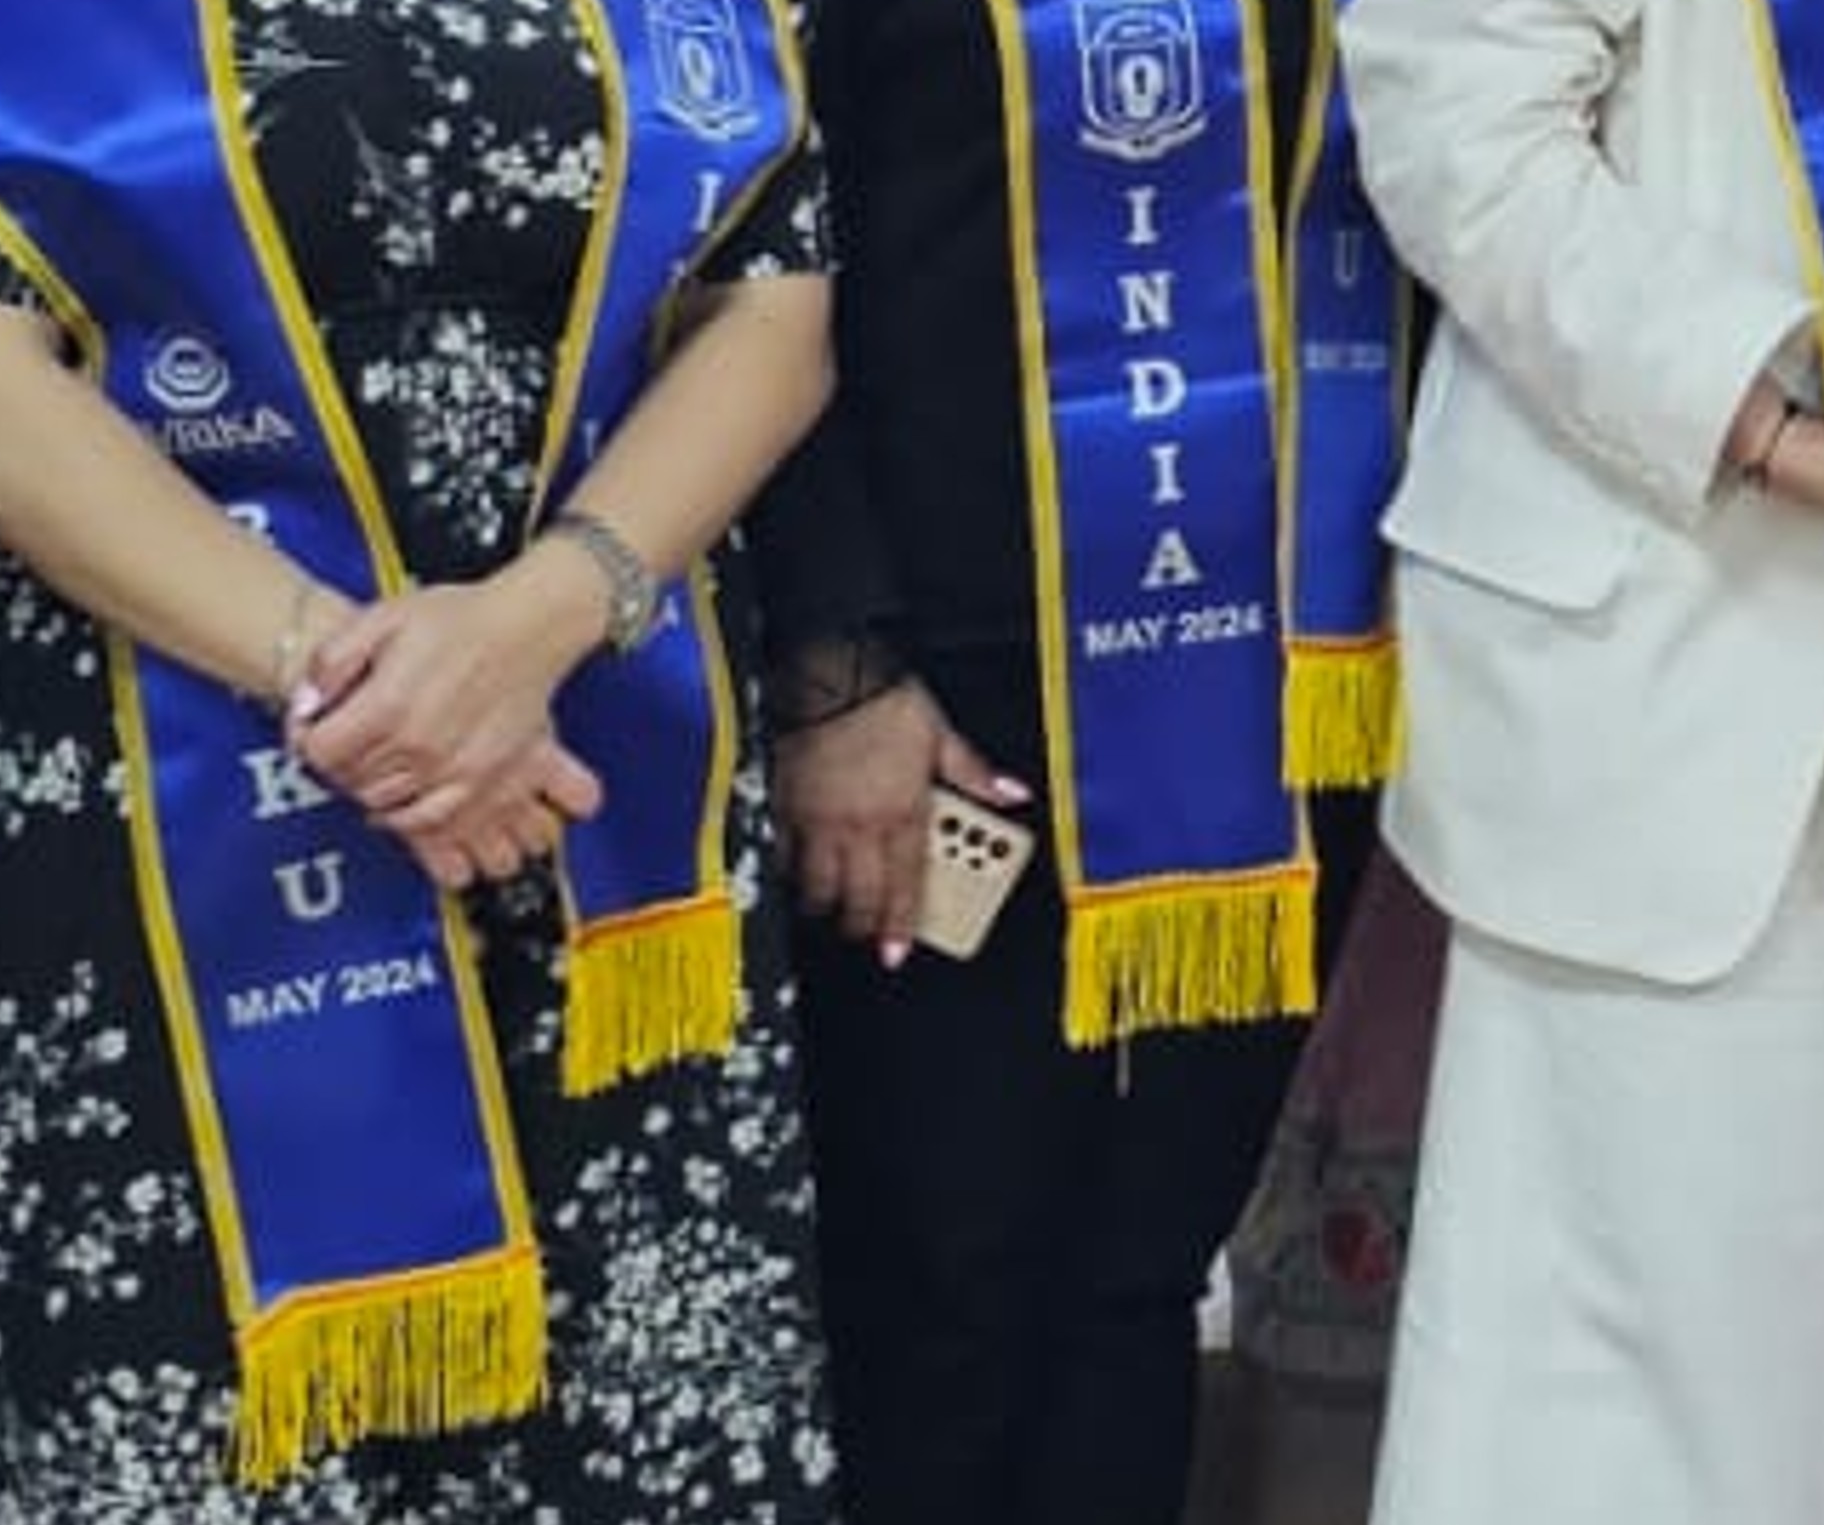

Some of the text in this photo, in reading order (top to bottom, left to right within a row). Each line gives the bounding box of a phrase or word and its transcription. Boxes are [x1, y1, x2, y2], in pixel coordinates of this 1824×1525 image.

[1120, 187, 1202, 588] INDIA
[1084, 603, 1264, 660] MAY 2024
[228, 960, 436, 1028] MAY 2024
